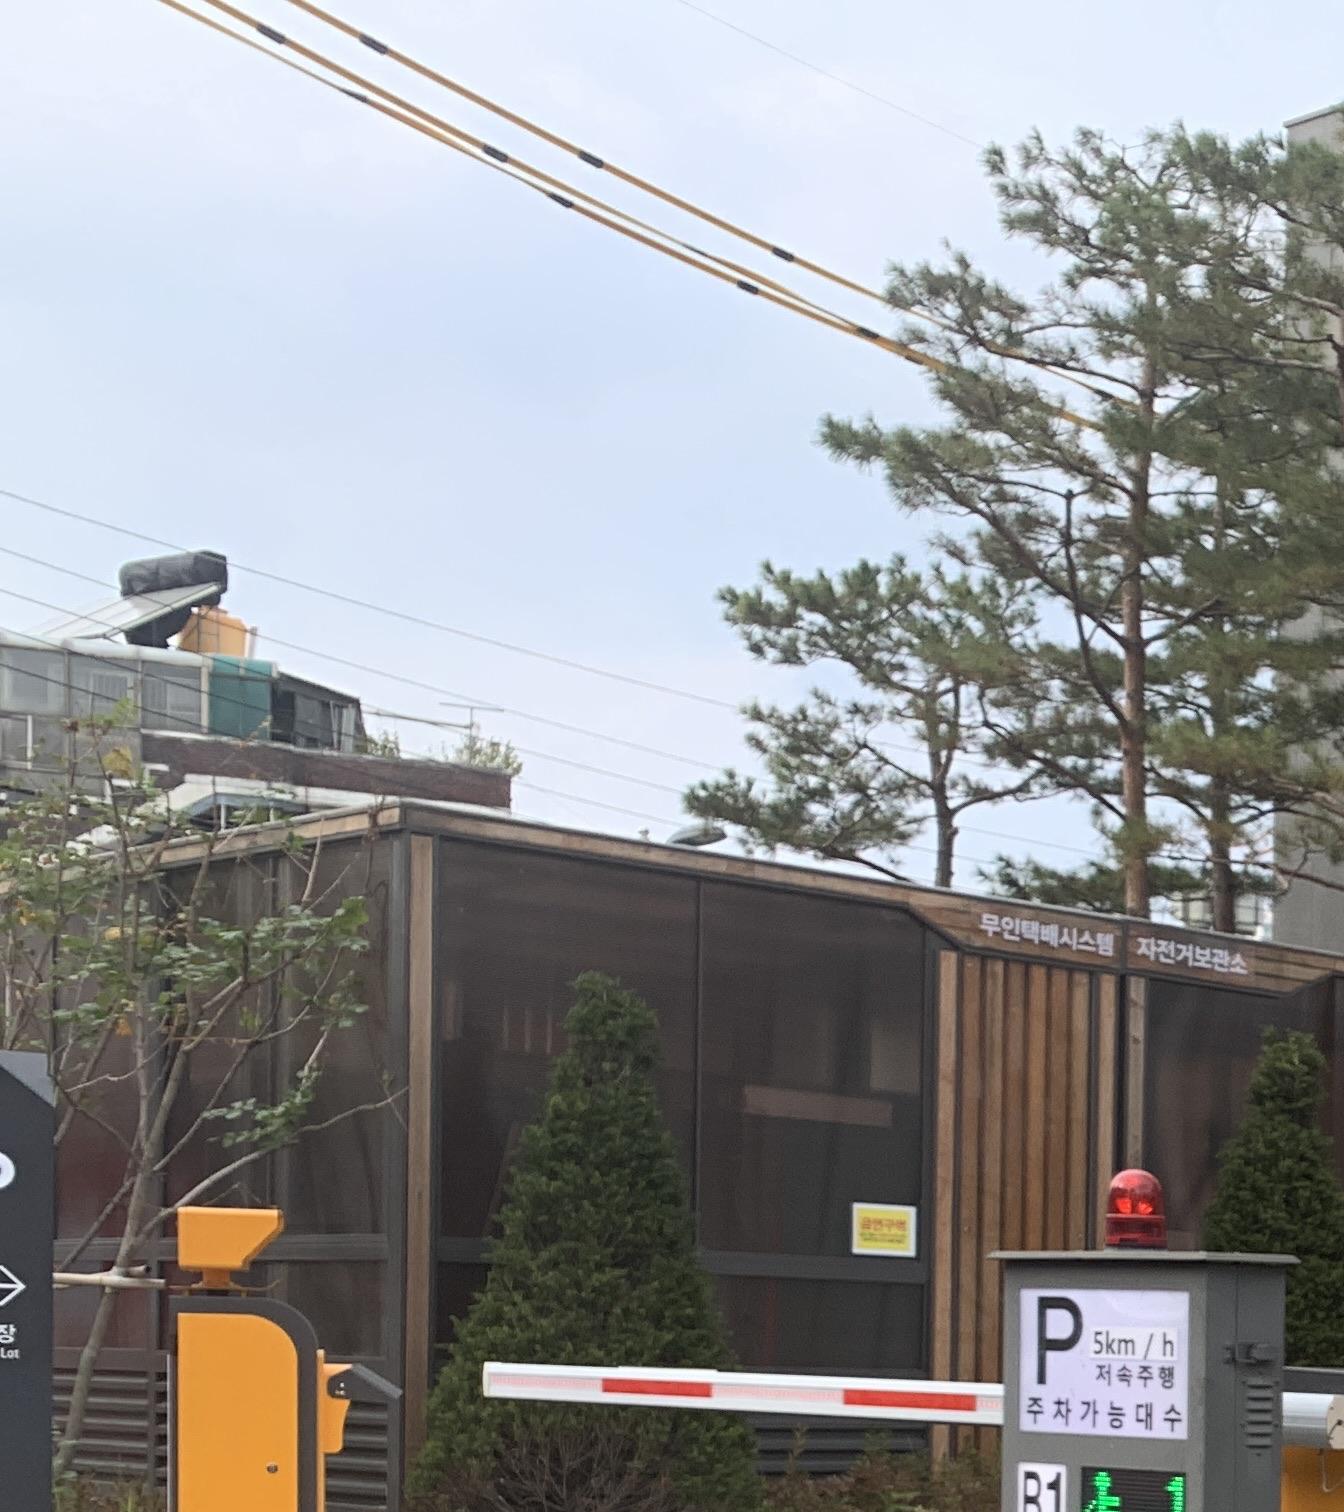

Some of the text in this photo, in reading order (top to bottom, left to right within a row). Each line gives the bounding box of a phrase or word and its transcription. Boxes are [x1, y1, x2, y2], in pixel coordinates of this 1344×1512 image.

[979, 913, 1115, 957] 무인택배시스템
[1136, 937, 1248, 974] 자전거보관소
[1037, 1296, 1083, 1385] P
[1096, 1363, 1175, 1389] 저속주행
